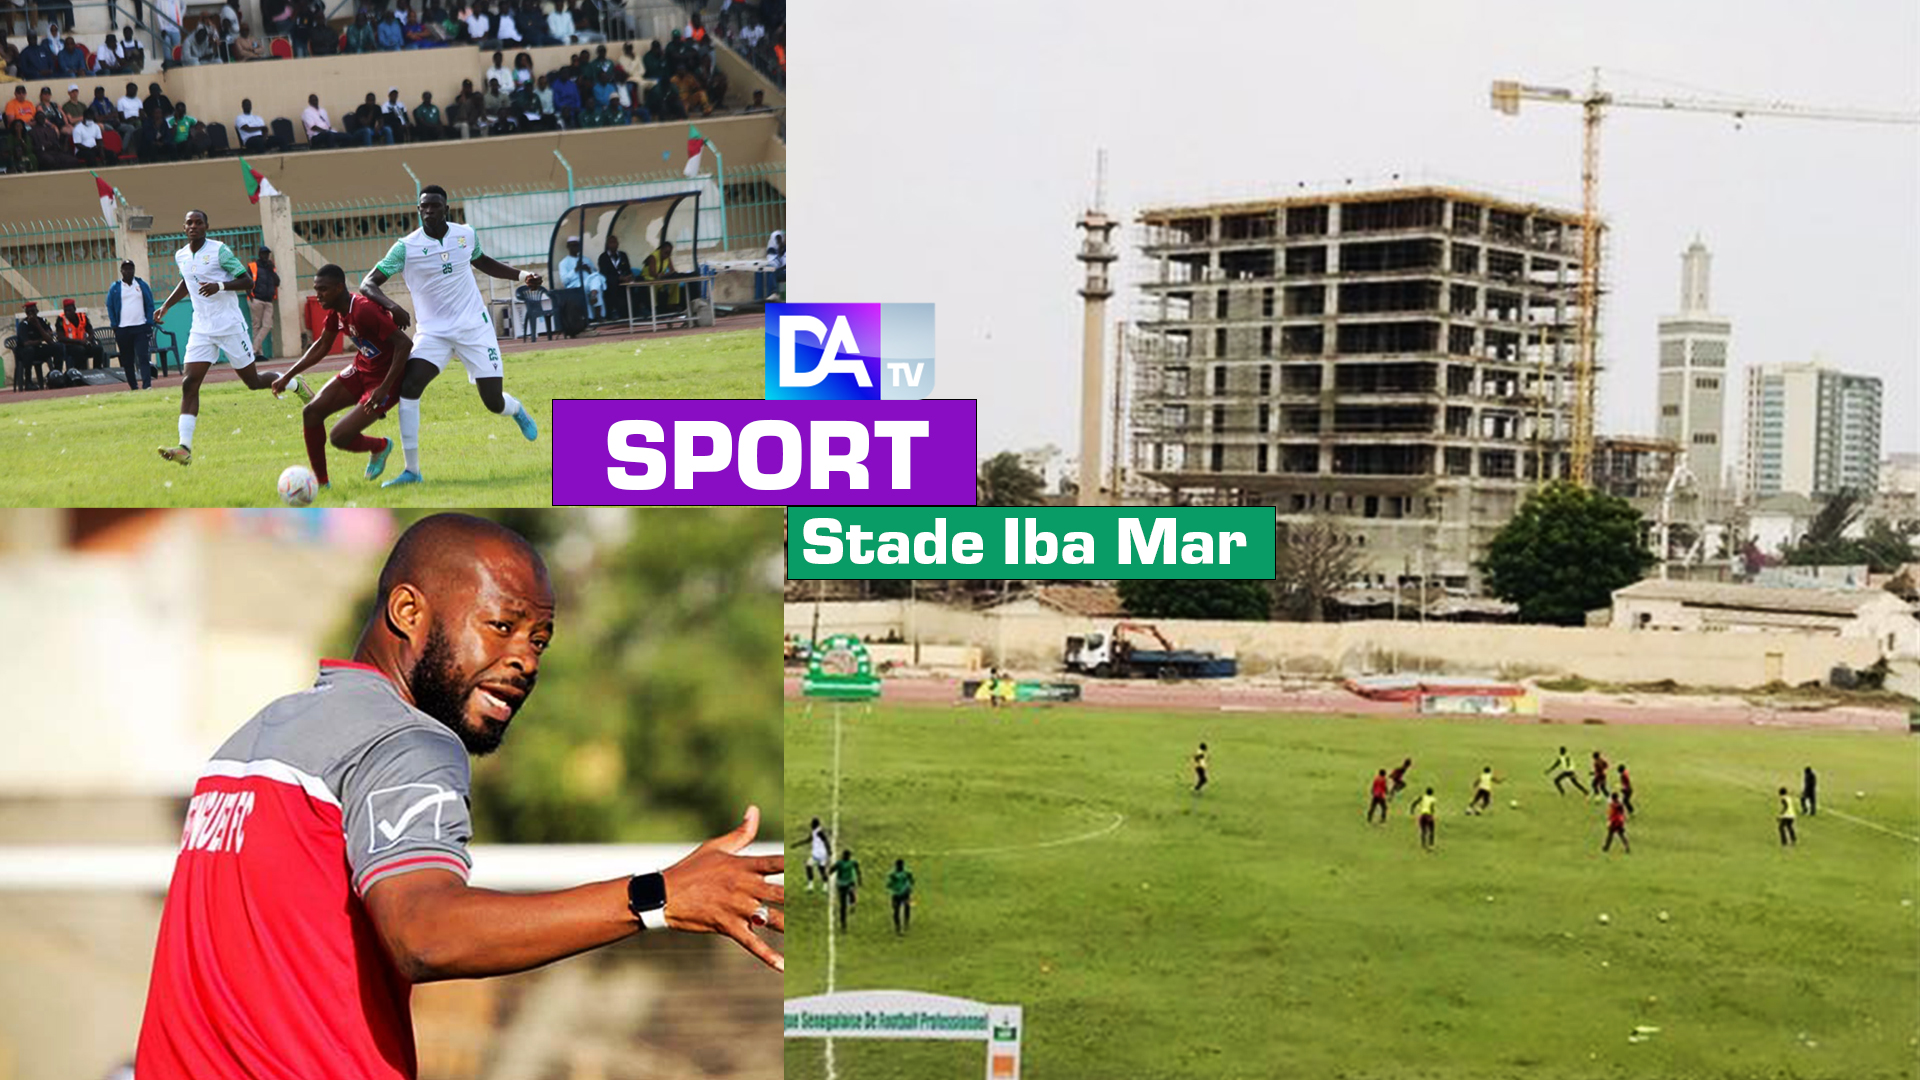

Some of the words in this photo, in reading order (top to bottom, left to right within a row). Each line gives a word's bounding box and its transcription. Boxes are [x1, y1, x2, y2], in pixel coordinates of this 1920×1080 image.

[441, 262, 453, 275] 25
[241, 340, 249, 352] 2
[879, 1011, 918, 1031] Football
